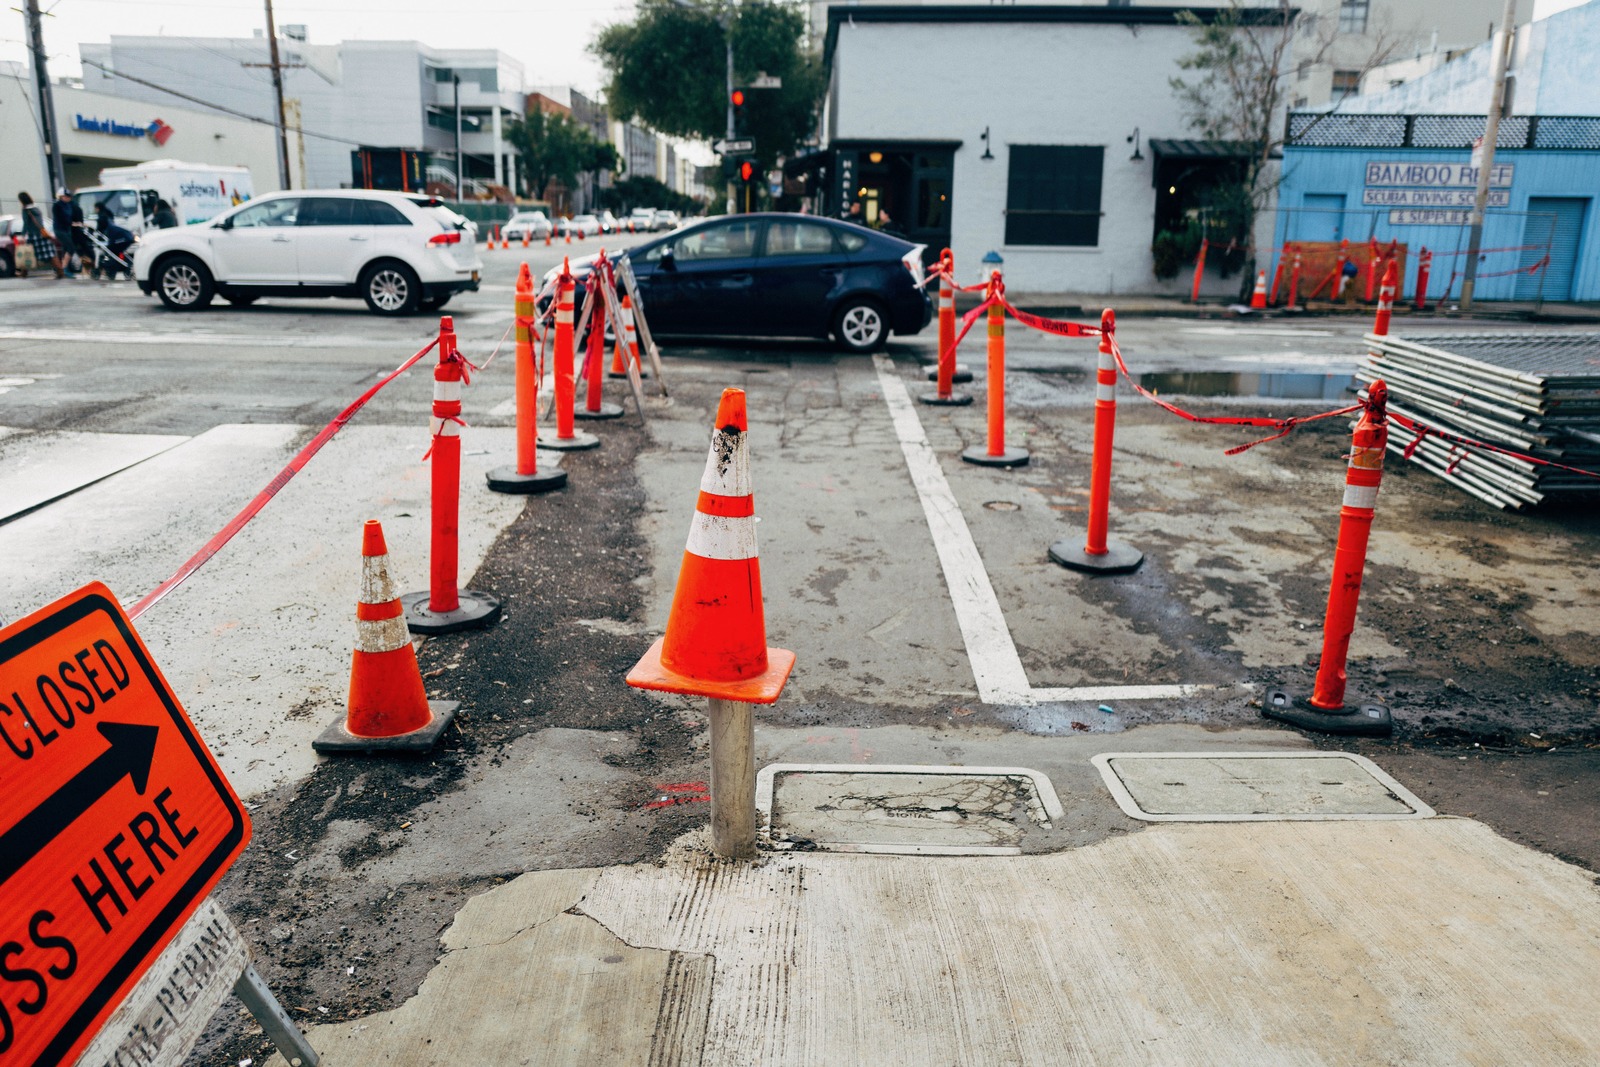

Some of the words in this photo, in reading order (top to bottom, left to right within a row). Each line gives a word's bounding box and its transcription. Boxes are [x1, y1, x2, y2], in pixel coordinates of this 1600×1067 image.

[1366, 191, 1407, 204] SCUBA
[1412, 192, 1452, 204] DIVING
[1458, 192, 1506, 206] SCOL
[1368, 165, 1450, 184] BAMBOO
[0, 639, 130, 760] CLOSED
[71, 786, 199, 935] HERE
